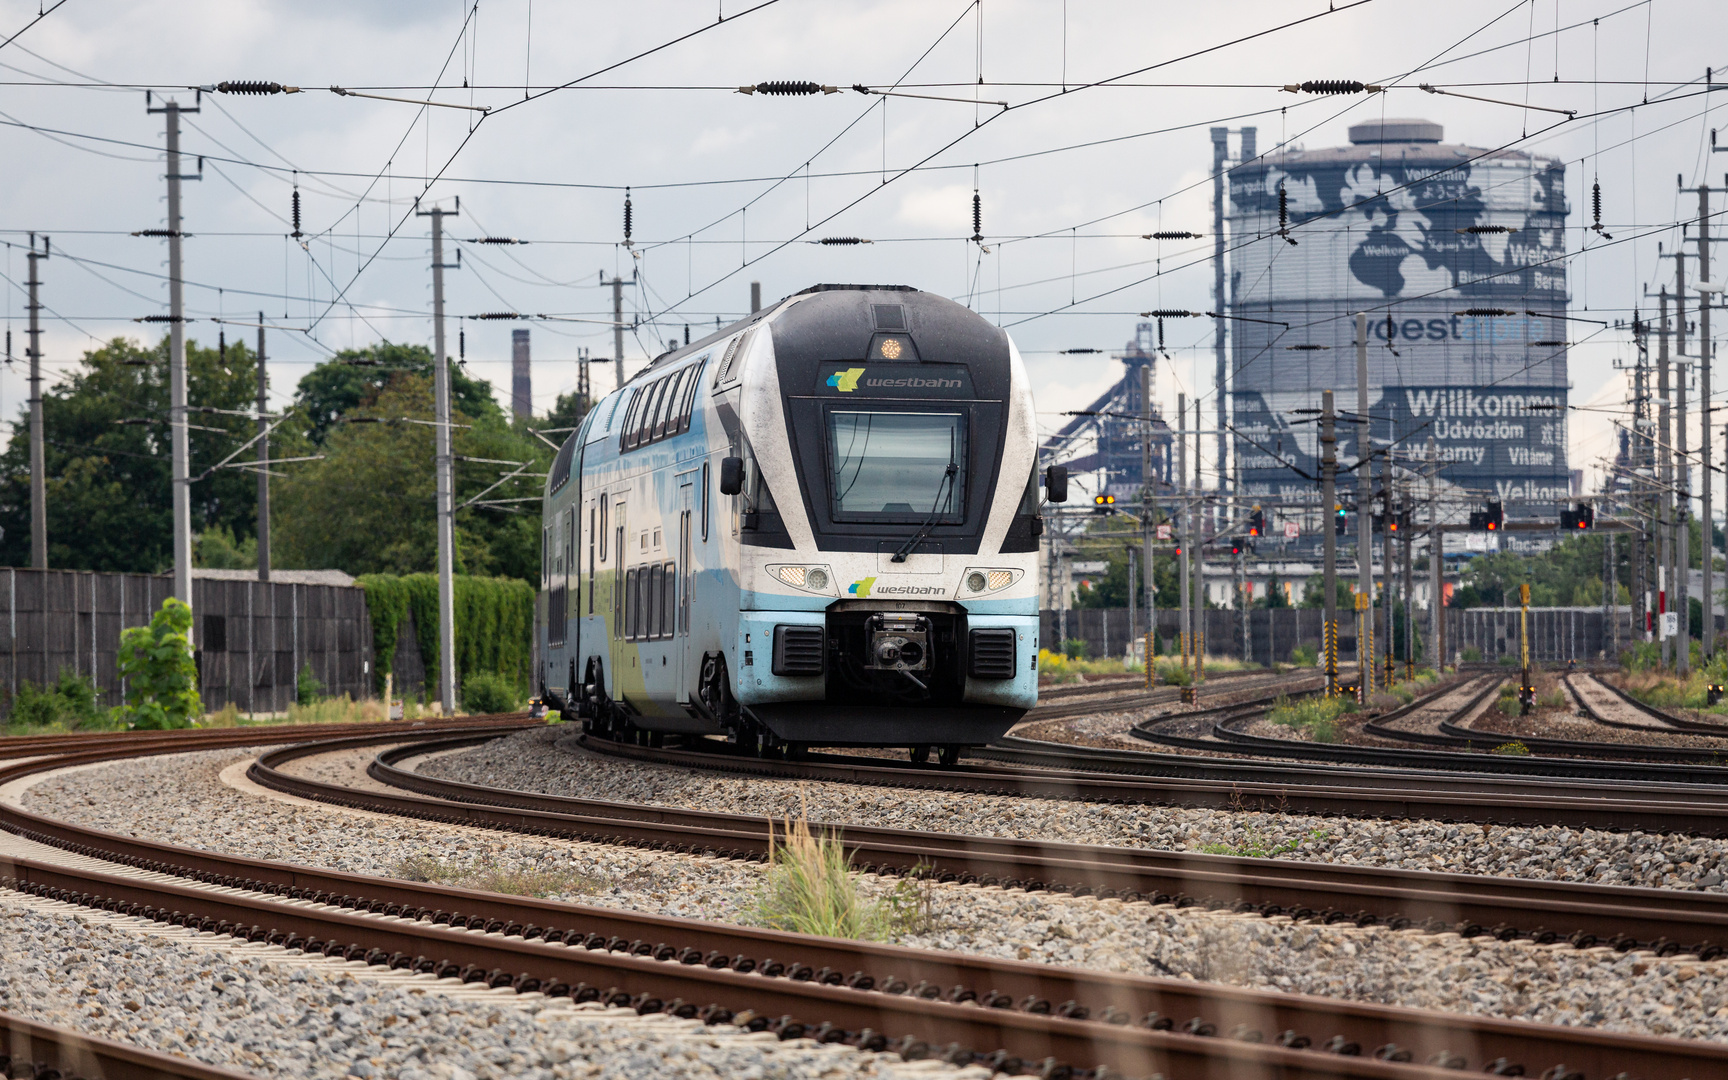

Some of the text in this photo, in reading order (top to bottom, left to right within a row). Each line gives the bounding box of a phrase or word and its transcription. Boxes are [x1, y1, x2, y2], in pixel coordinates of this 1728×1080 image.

[866, 378, 962, 388] westbahn
[1406, 443, 1485, 465] Wtamy
[877, 586, 945, 595] westbahn
